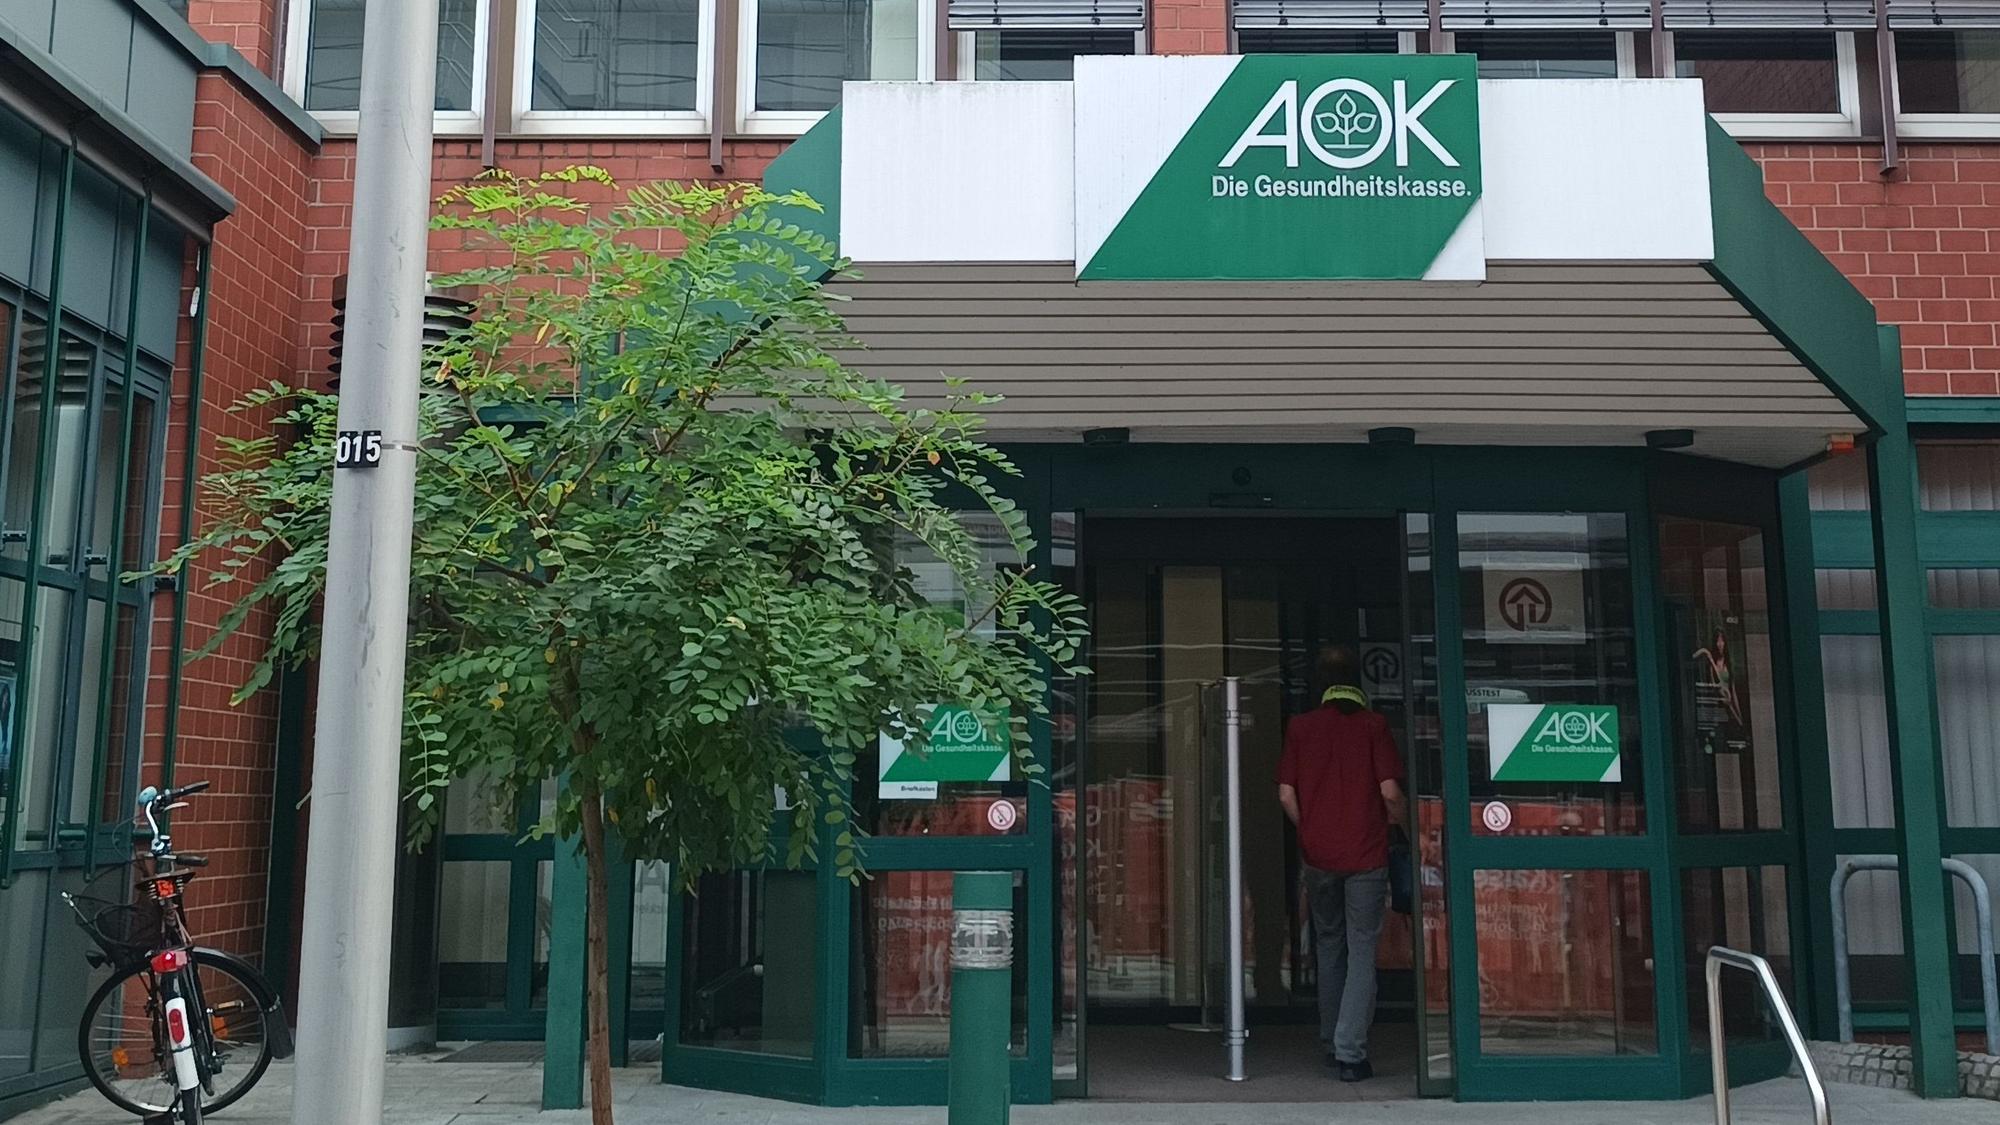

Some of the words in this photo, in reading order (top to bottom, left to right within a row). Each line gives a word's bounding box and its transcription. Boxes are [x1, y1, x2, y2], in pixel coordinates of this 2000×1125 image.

[1217, 78, 1463, 169] AOK
[1212, 175, 1249, 197] Die
[1254, 175, 1472, 198] Gesundheitskasse.
[337, 436, 381, 462] 015
[1533, 711, 1613, 744] AOK
[1532, 744, 1543, 752] Die
